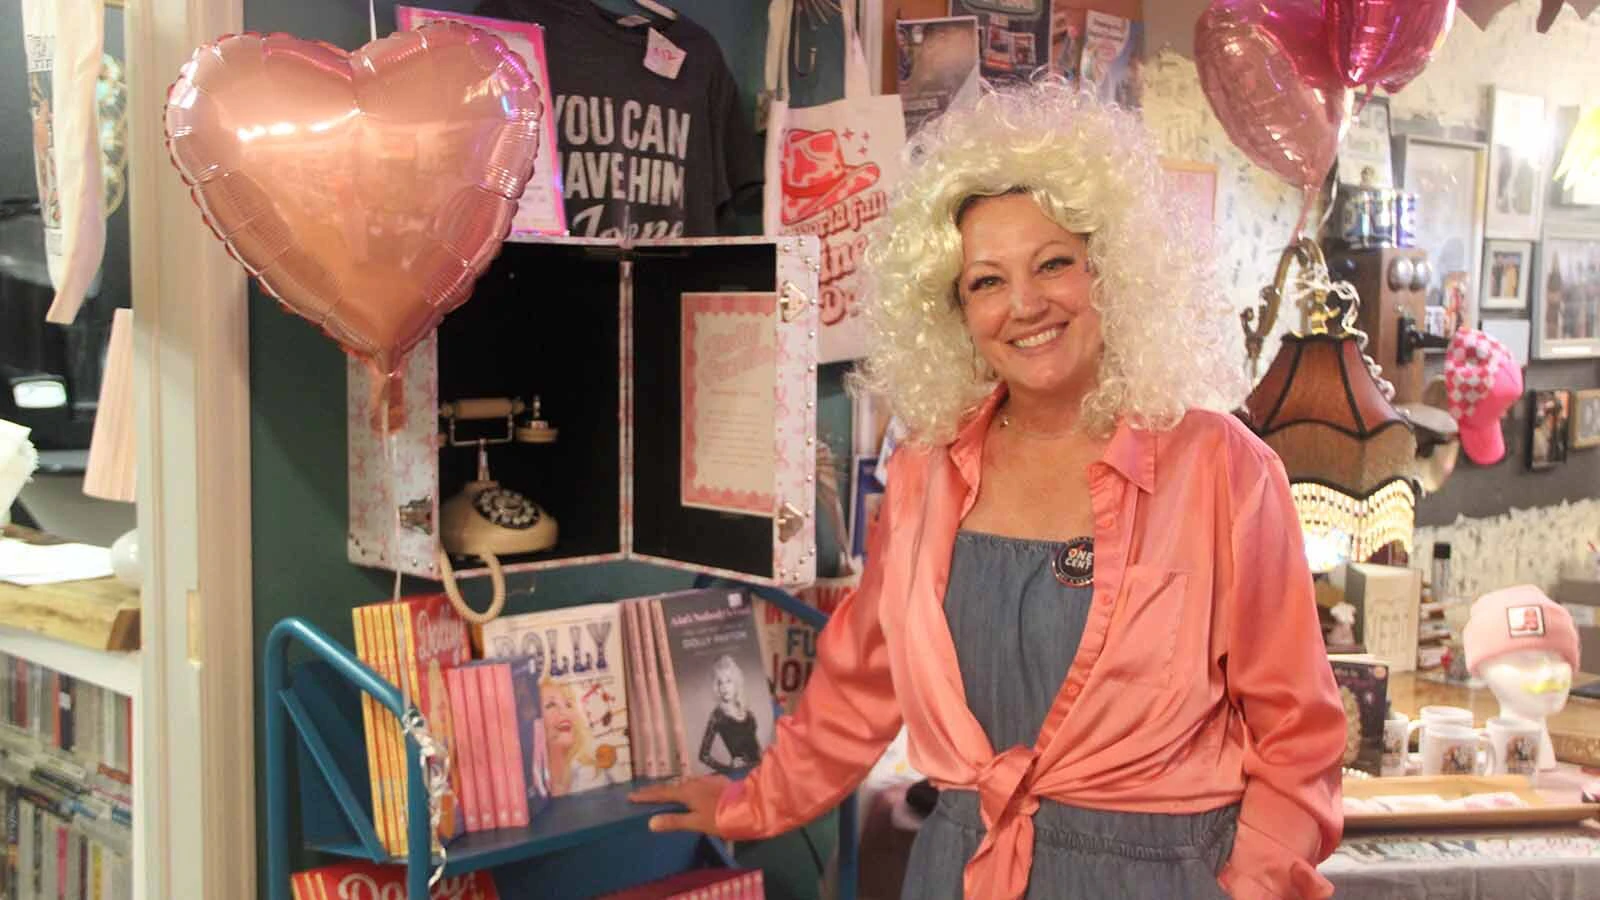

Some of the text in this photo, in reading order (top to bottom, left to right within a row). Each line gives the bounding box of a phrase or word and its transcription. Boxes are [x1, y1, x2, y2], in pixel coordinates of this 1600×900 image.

[553, 95, 690, 160] YOU CAN
[559, 152, 685, 209] AVE HIM
